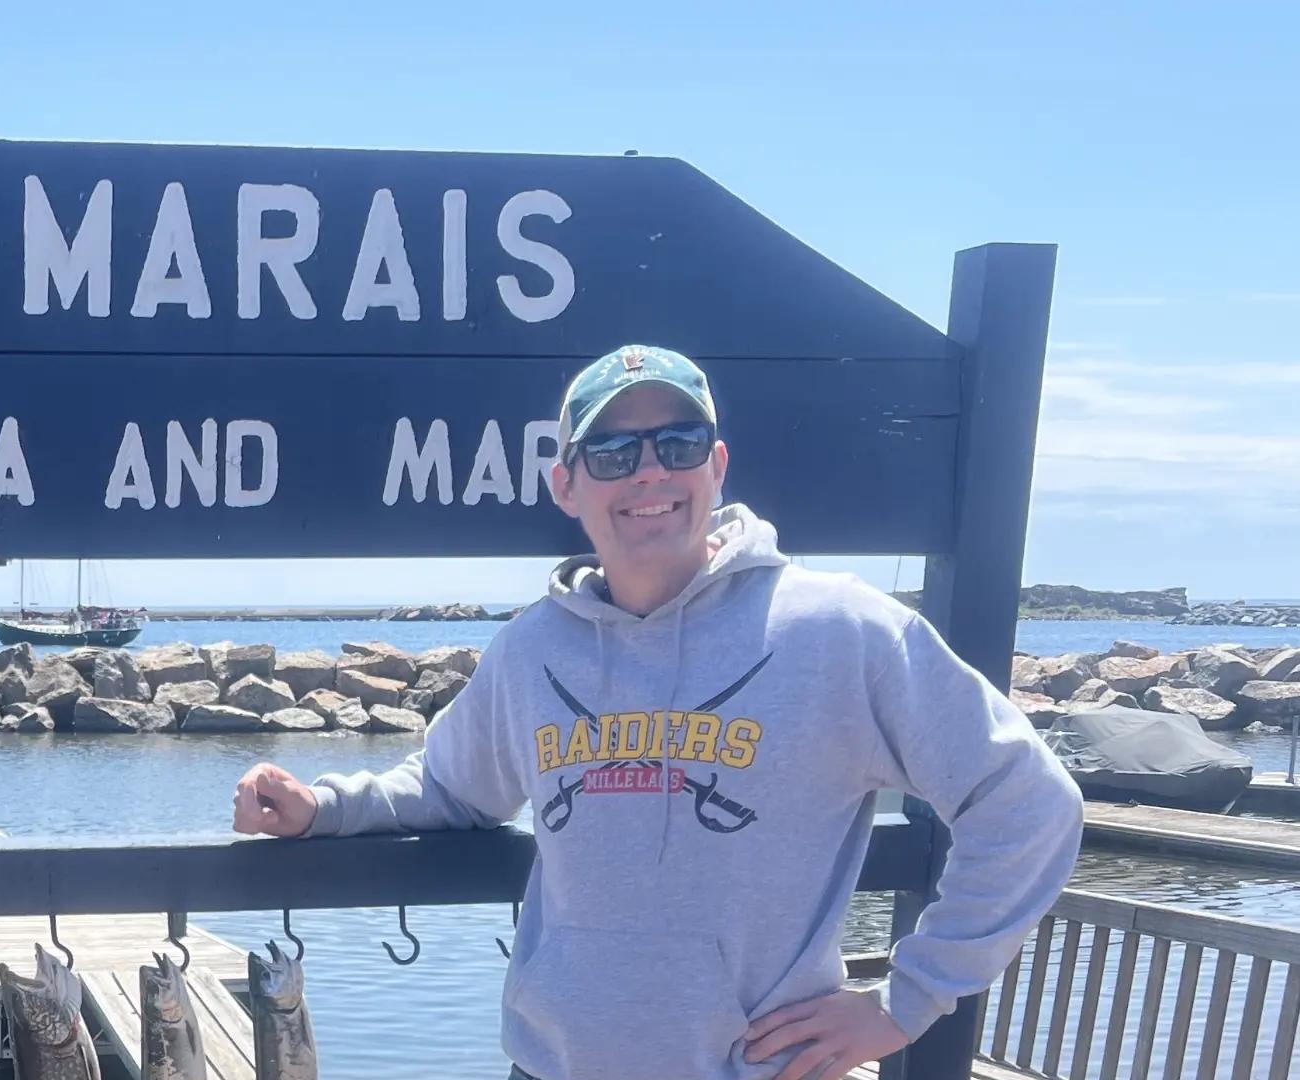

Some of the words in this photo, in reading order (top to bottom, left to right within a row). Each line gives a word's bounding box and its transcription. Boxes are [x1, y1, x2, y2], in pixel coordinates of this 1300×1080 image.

[23, 175, 576, 323] MARAIS
[104, 418, 279, 510] AND
[534, 710, 763, 775] RAIDERS
[585, 771, 635, 790] MILLE
